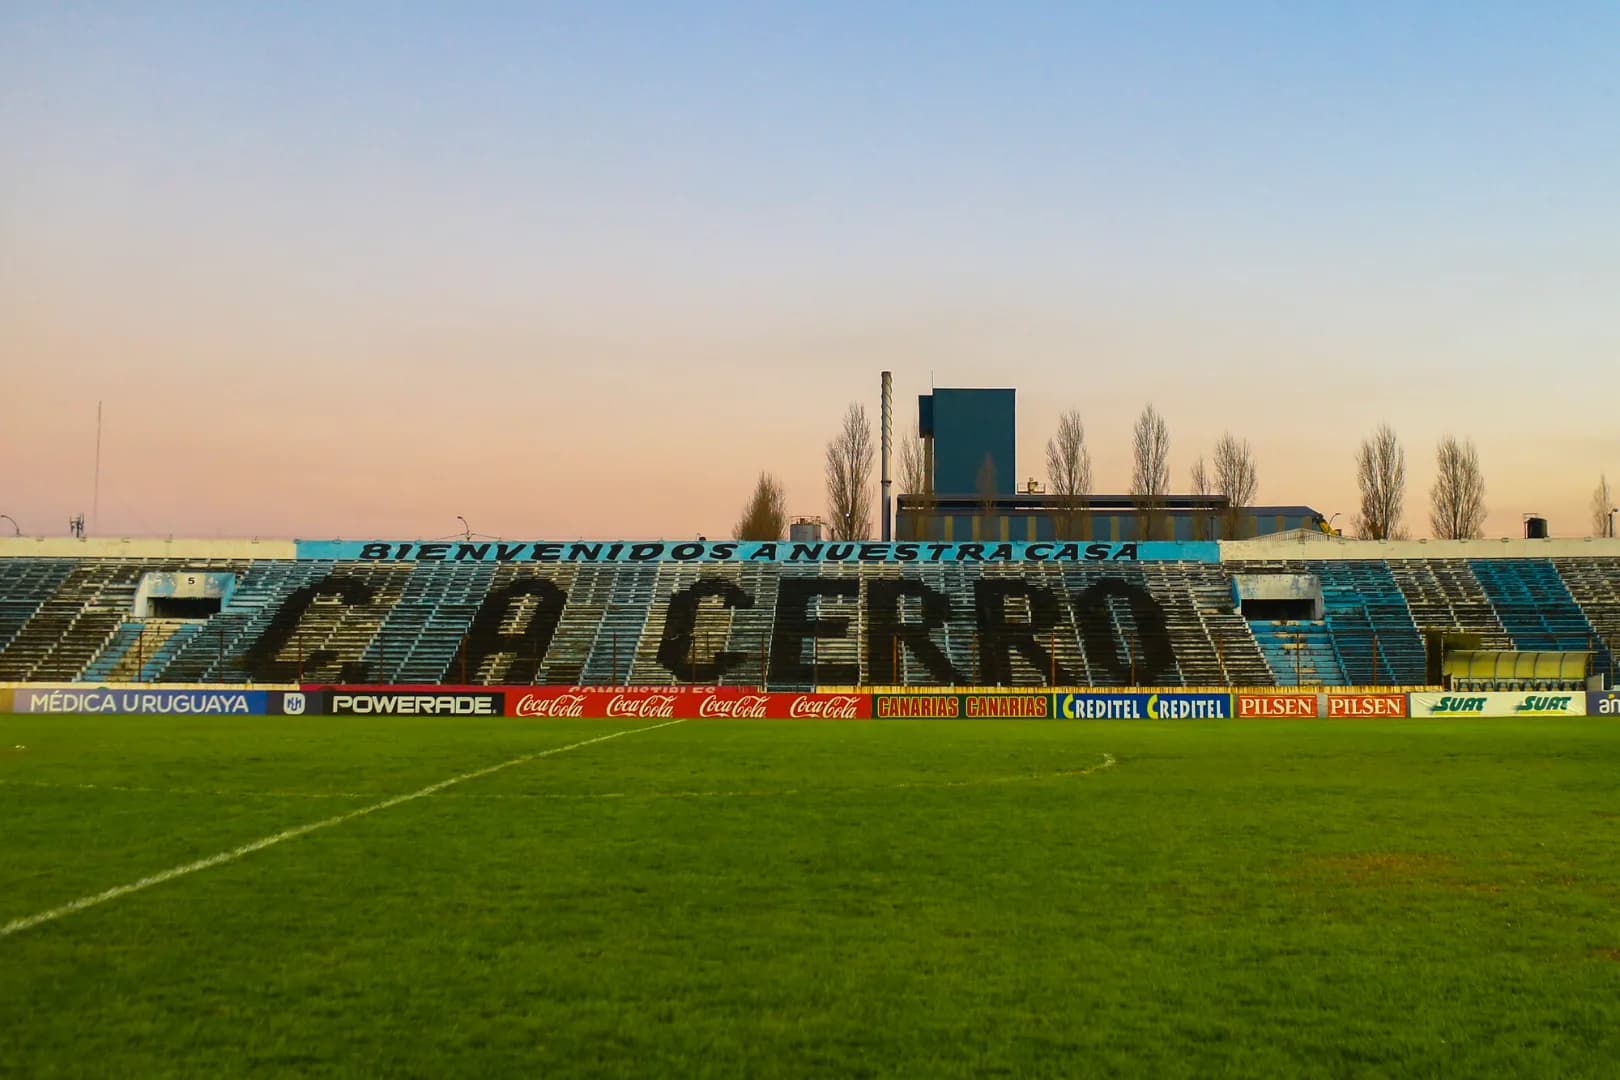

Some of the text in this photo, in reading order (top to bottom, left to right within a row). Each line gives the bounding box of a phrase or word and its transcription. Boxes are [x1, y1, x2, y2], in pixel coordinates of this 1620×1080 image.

[359, 543, 1138, 560] BIENVENIDOS A NUESTRA CASA
[657, 577, 1178, 686] CERRO
[30, 690, 249, 713] MÉDICA URUGUAYA
[333, 695, 492, 713] POWERADE
[877, 696, 959, 718] CANARIAS
[966, 696, 1047, 717] CANARIAS
[1063, 694, 1140, 719] CREDITEL
[1147, 694, 1224, 719] CREDITEL
[1241, 698, 1312, 715] PILSEN
[1331, 698, 1401, 714] PILSEN
[1434, 696, 1487, 712] SUAT
[1518, 696, 1572, 711] SUAT
